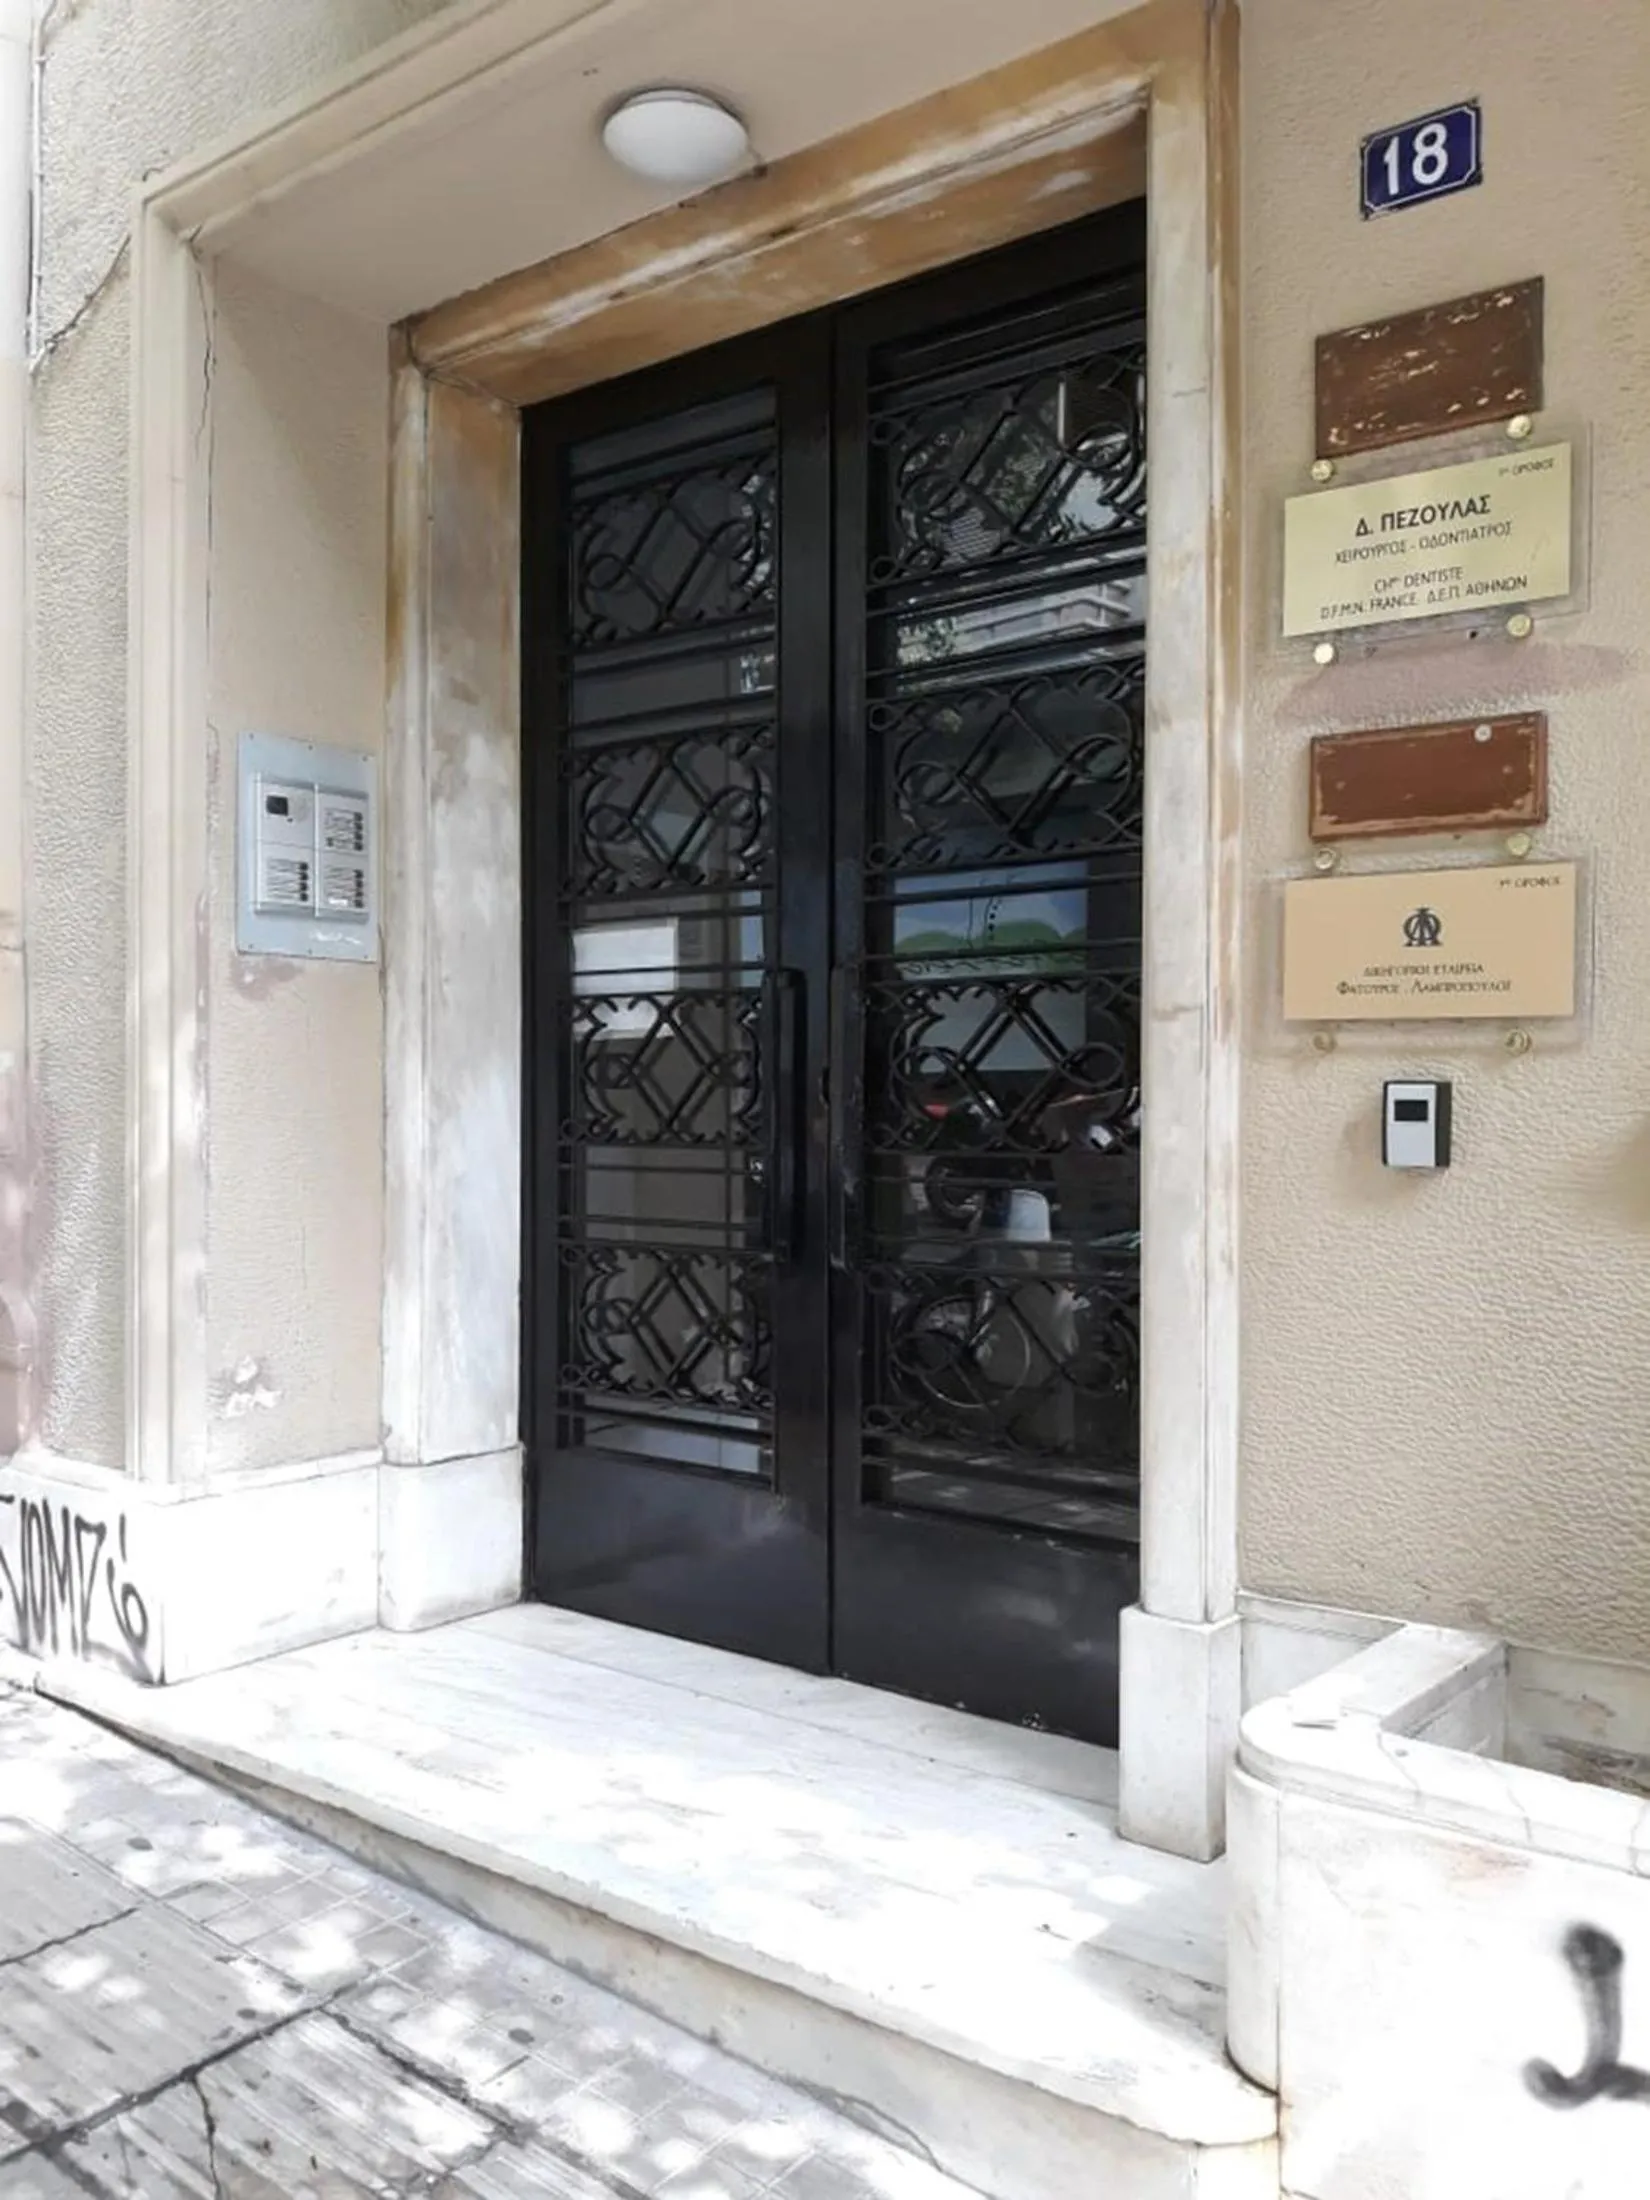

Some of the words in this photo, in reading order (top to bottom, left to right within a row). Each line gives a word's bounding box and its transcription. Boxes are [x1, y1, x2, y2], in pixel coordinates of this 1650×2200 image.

[1383, 122, 1448, 196] 18
[1355, 517, 1374, 537] Δ.
[1380, 494, 1491, 532] ΠΕΖΟΥΛΑΣ
[1335, 540, 1408, 564] ΧΕΙΡΟΥΡΓΟΣ
[1419, 520, 1513, 550] ΟΔΟΝΤΙΑΤΡΟΣ
[1403, 566, 1465, 588] DENTISTE
[1465, 574, 1528, 597] ΑΘΗΝΩΝ
[1370, 592, 1417, 612] FRANCE
